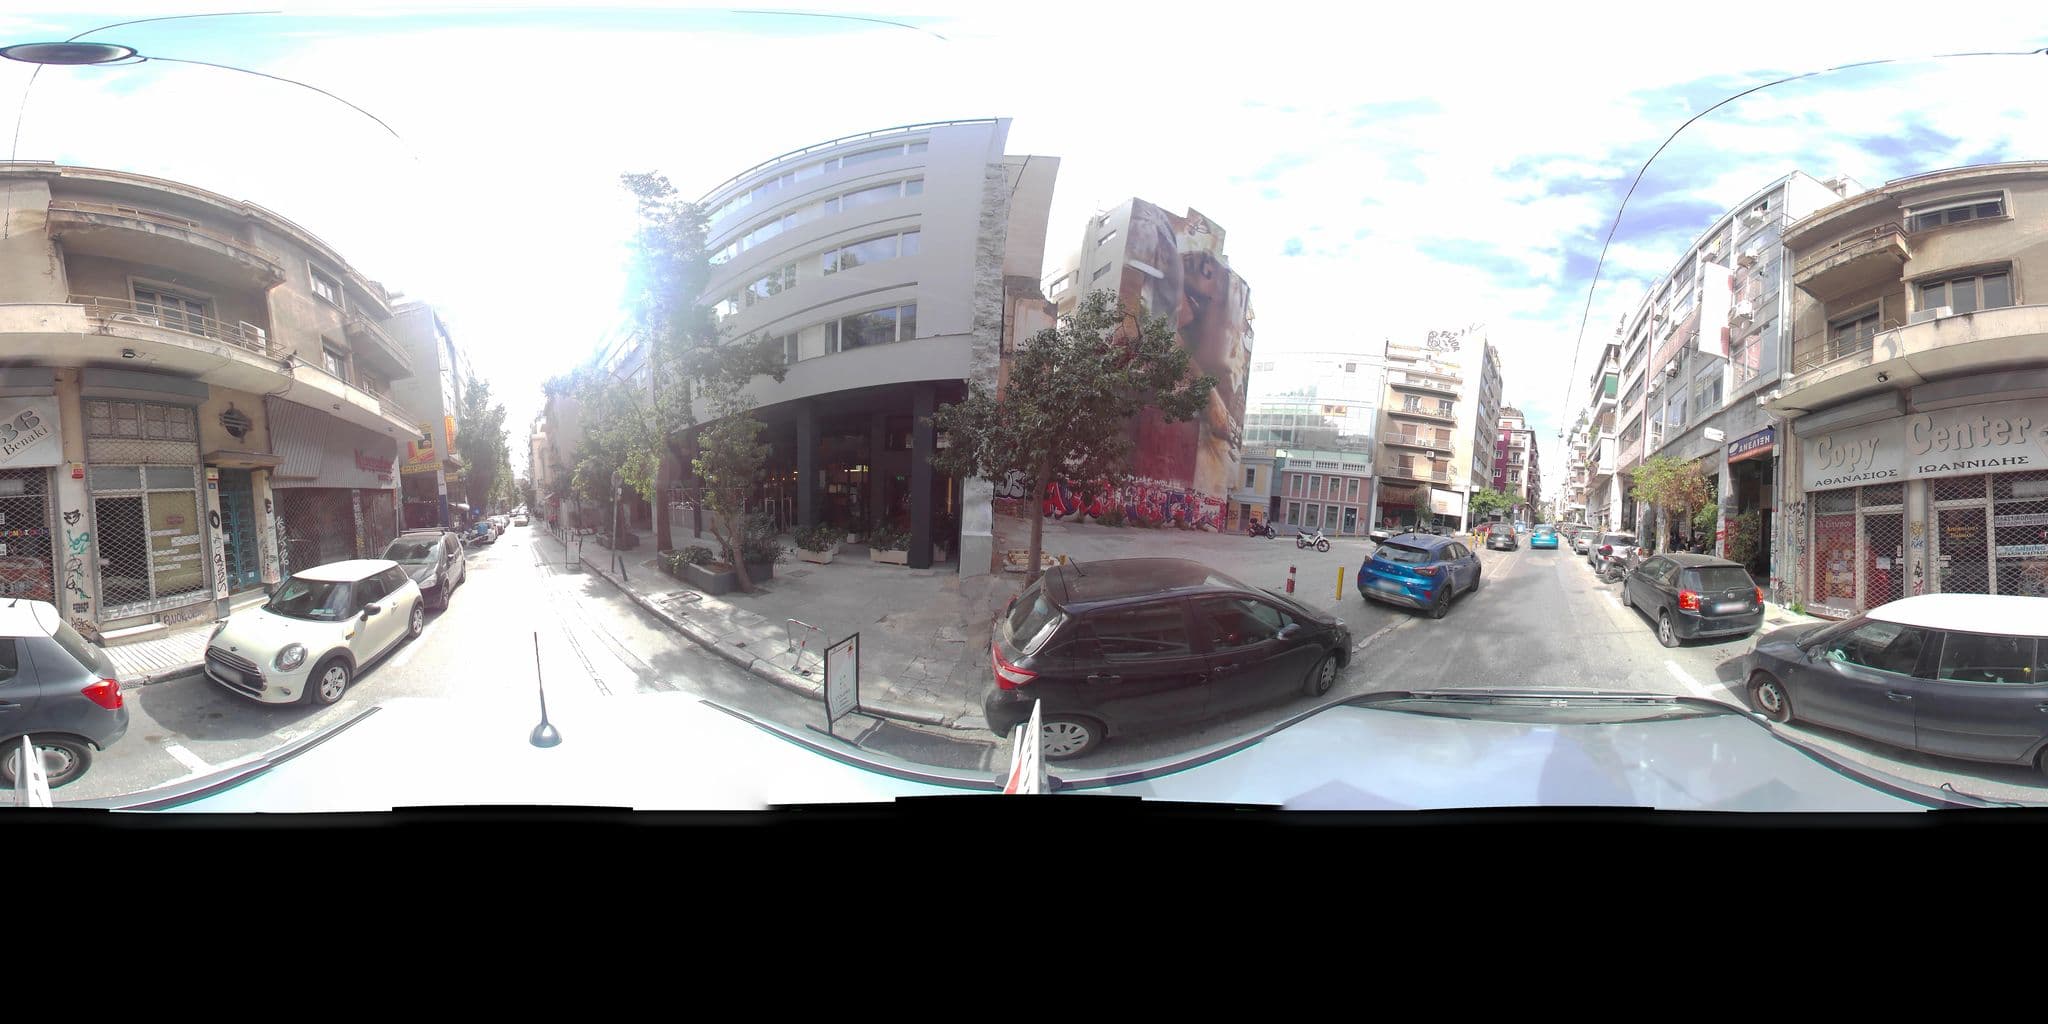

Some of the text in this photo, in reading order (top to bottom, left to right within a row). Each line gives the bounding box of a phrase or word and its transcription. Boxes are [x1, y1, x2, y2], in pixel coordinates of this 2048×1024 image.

[3, 425, 48, 455] Benaki
[1738, 435, 1770, 453] ΑΝΕΛΙΞΗ
[1815, 415, 2032, 472] Copy Center
[1814, 456, 2030, 487] ΑΘΑΝΑΣΙΟΣ ΙΩΑΝΝΙΔΗΣ
